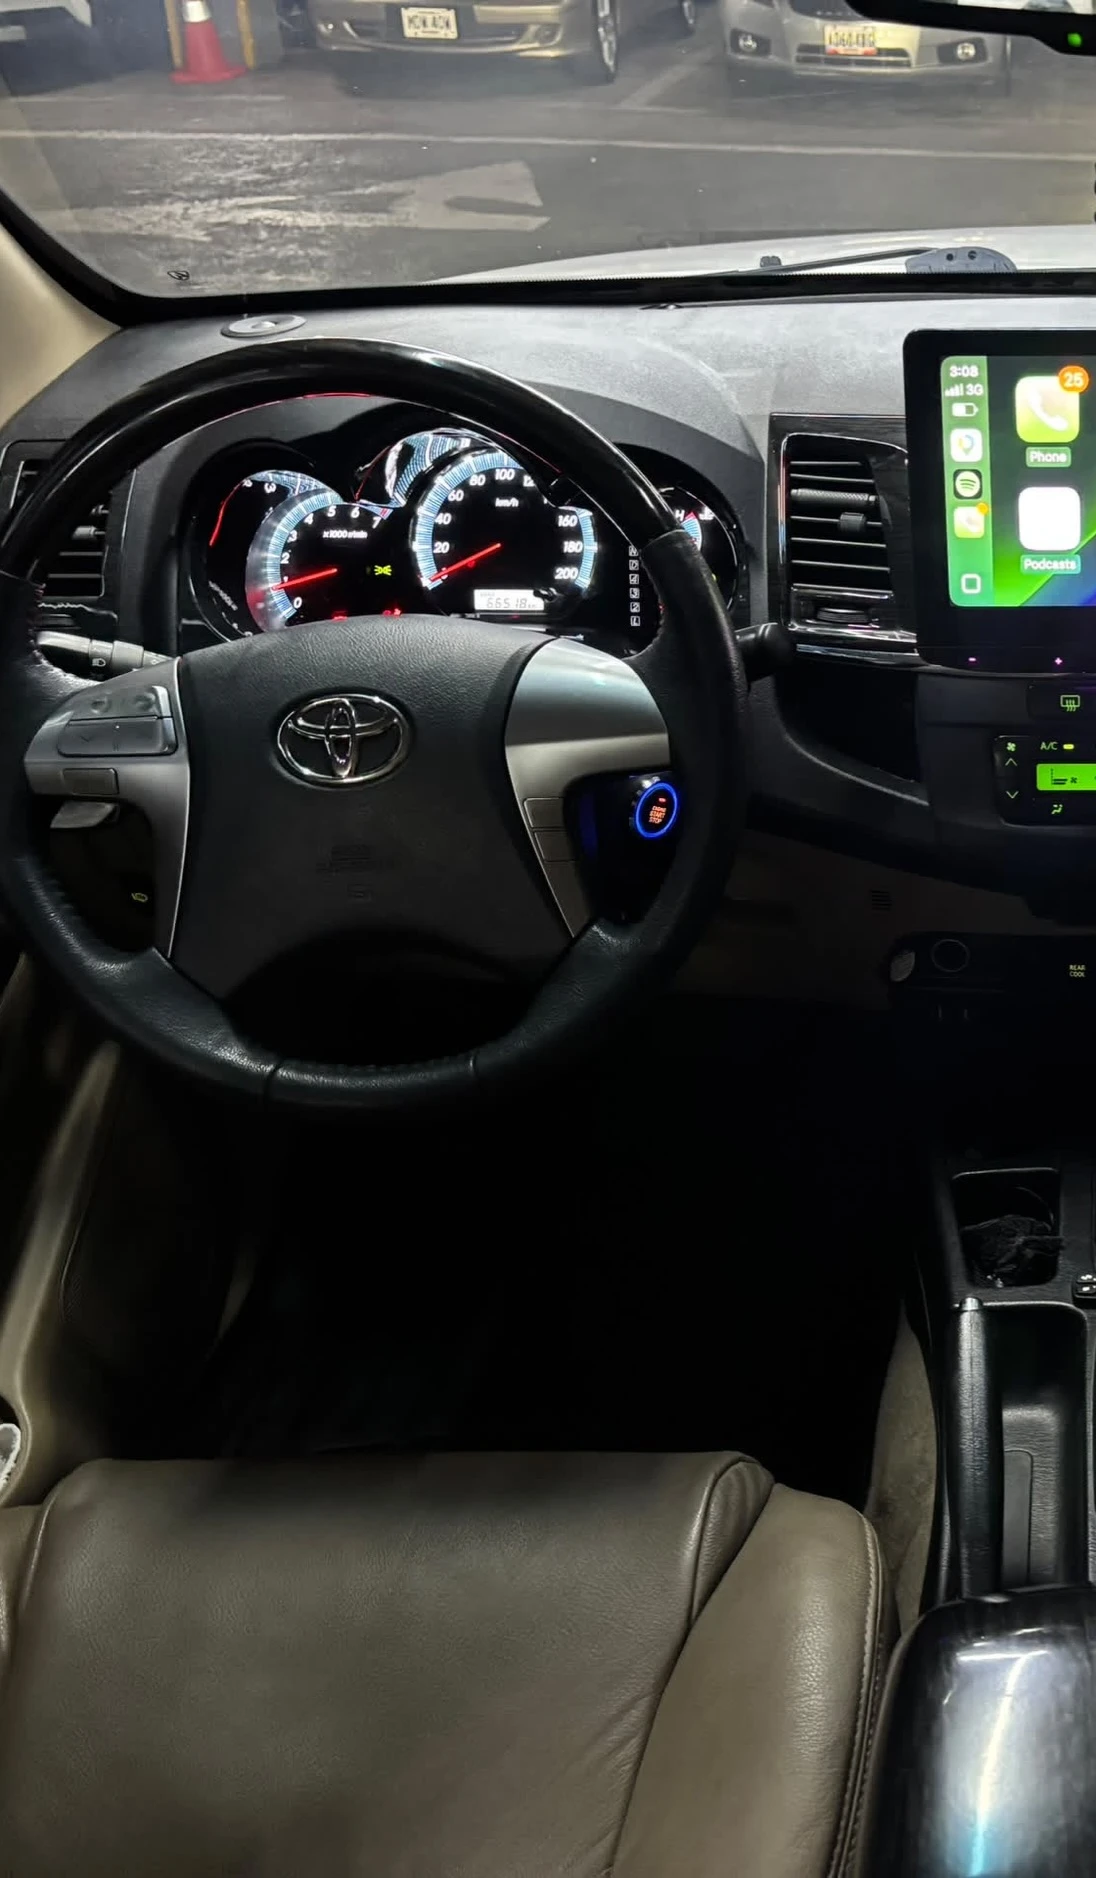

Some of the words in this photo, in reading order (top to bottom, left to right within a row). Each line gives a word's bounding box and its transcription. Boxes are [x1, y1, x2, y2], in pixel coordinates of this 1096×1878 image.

[950, 365, 979, 378] 3:08
[1064, 373, 1083, 388] 25
[966, 384, 984, 396] 3G
[1029, 451, 1067, 463] Phone
[469, 474, 486, 486] 80
[495, 469, 515, 480] 100
[448, 489, 464, 501] 60
[495, 498, 519, 507] km/h
[328, 506, 337, 517] 5
[351, 507, 360, 518] 6
[675, 509, 685, 521] H
[304, 513, 314, 525] 4
[372, 517, 382, 529] 7
[436, 513, 452, 525] 40
[558, 515, 578, 527] 160
[287, 530, 298, 542] 3
[433, 542, 450, 554] 20
[563, 541, 583, 553] 180
[280, 552, 290, 564] 2
[1023, 558, 1077, 571] Podcasts
[554, 568, 578, 580] 200
[294, 597, 303, 608] 0
[486, 598, 527, 609] 66518
[1040, 741, 1058, 750] A/C
[1069, 970, 1086, 978] COOL
